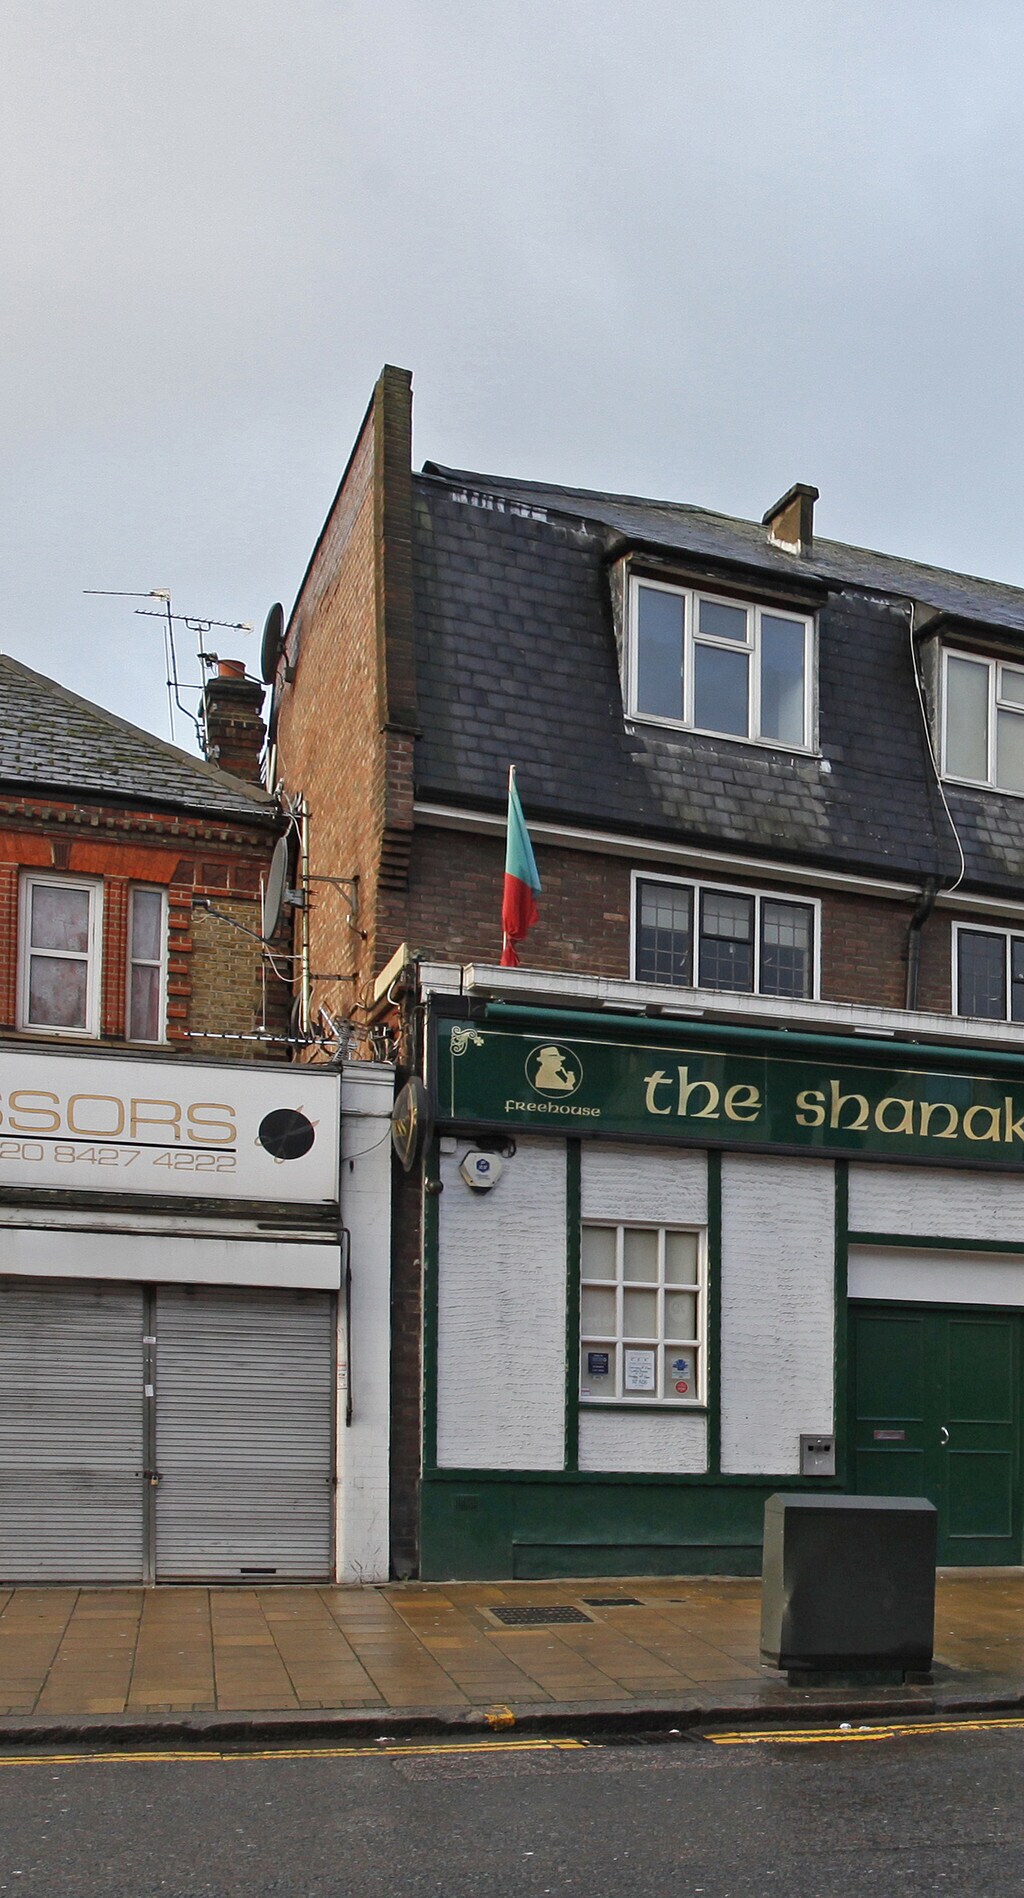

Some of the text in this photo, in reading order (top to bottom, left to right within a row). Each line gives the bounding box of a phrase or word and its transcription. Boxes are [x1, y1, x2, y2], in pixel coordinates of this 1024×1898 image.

[0, 1089, 237, 1144] SORS
[643, 1065, 763, 1122] the
[54, 1145, 141, 1168] 8427
[153, 1151, 237, 1174] 4222
